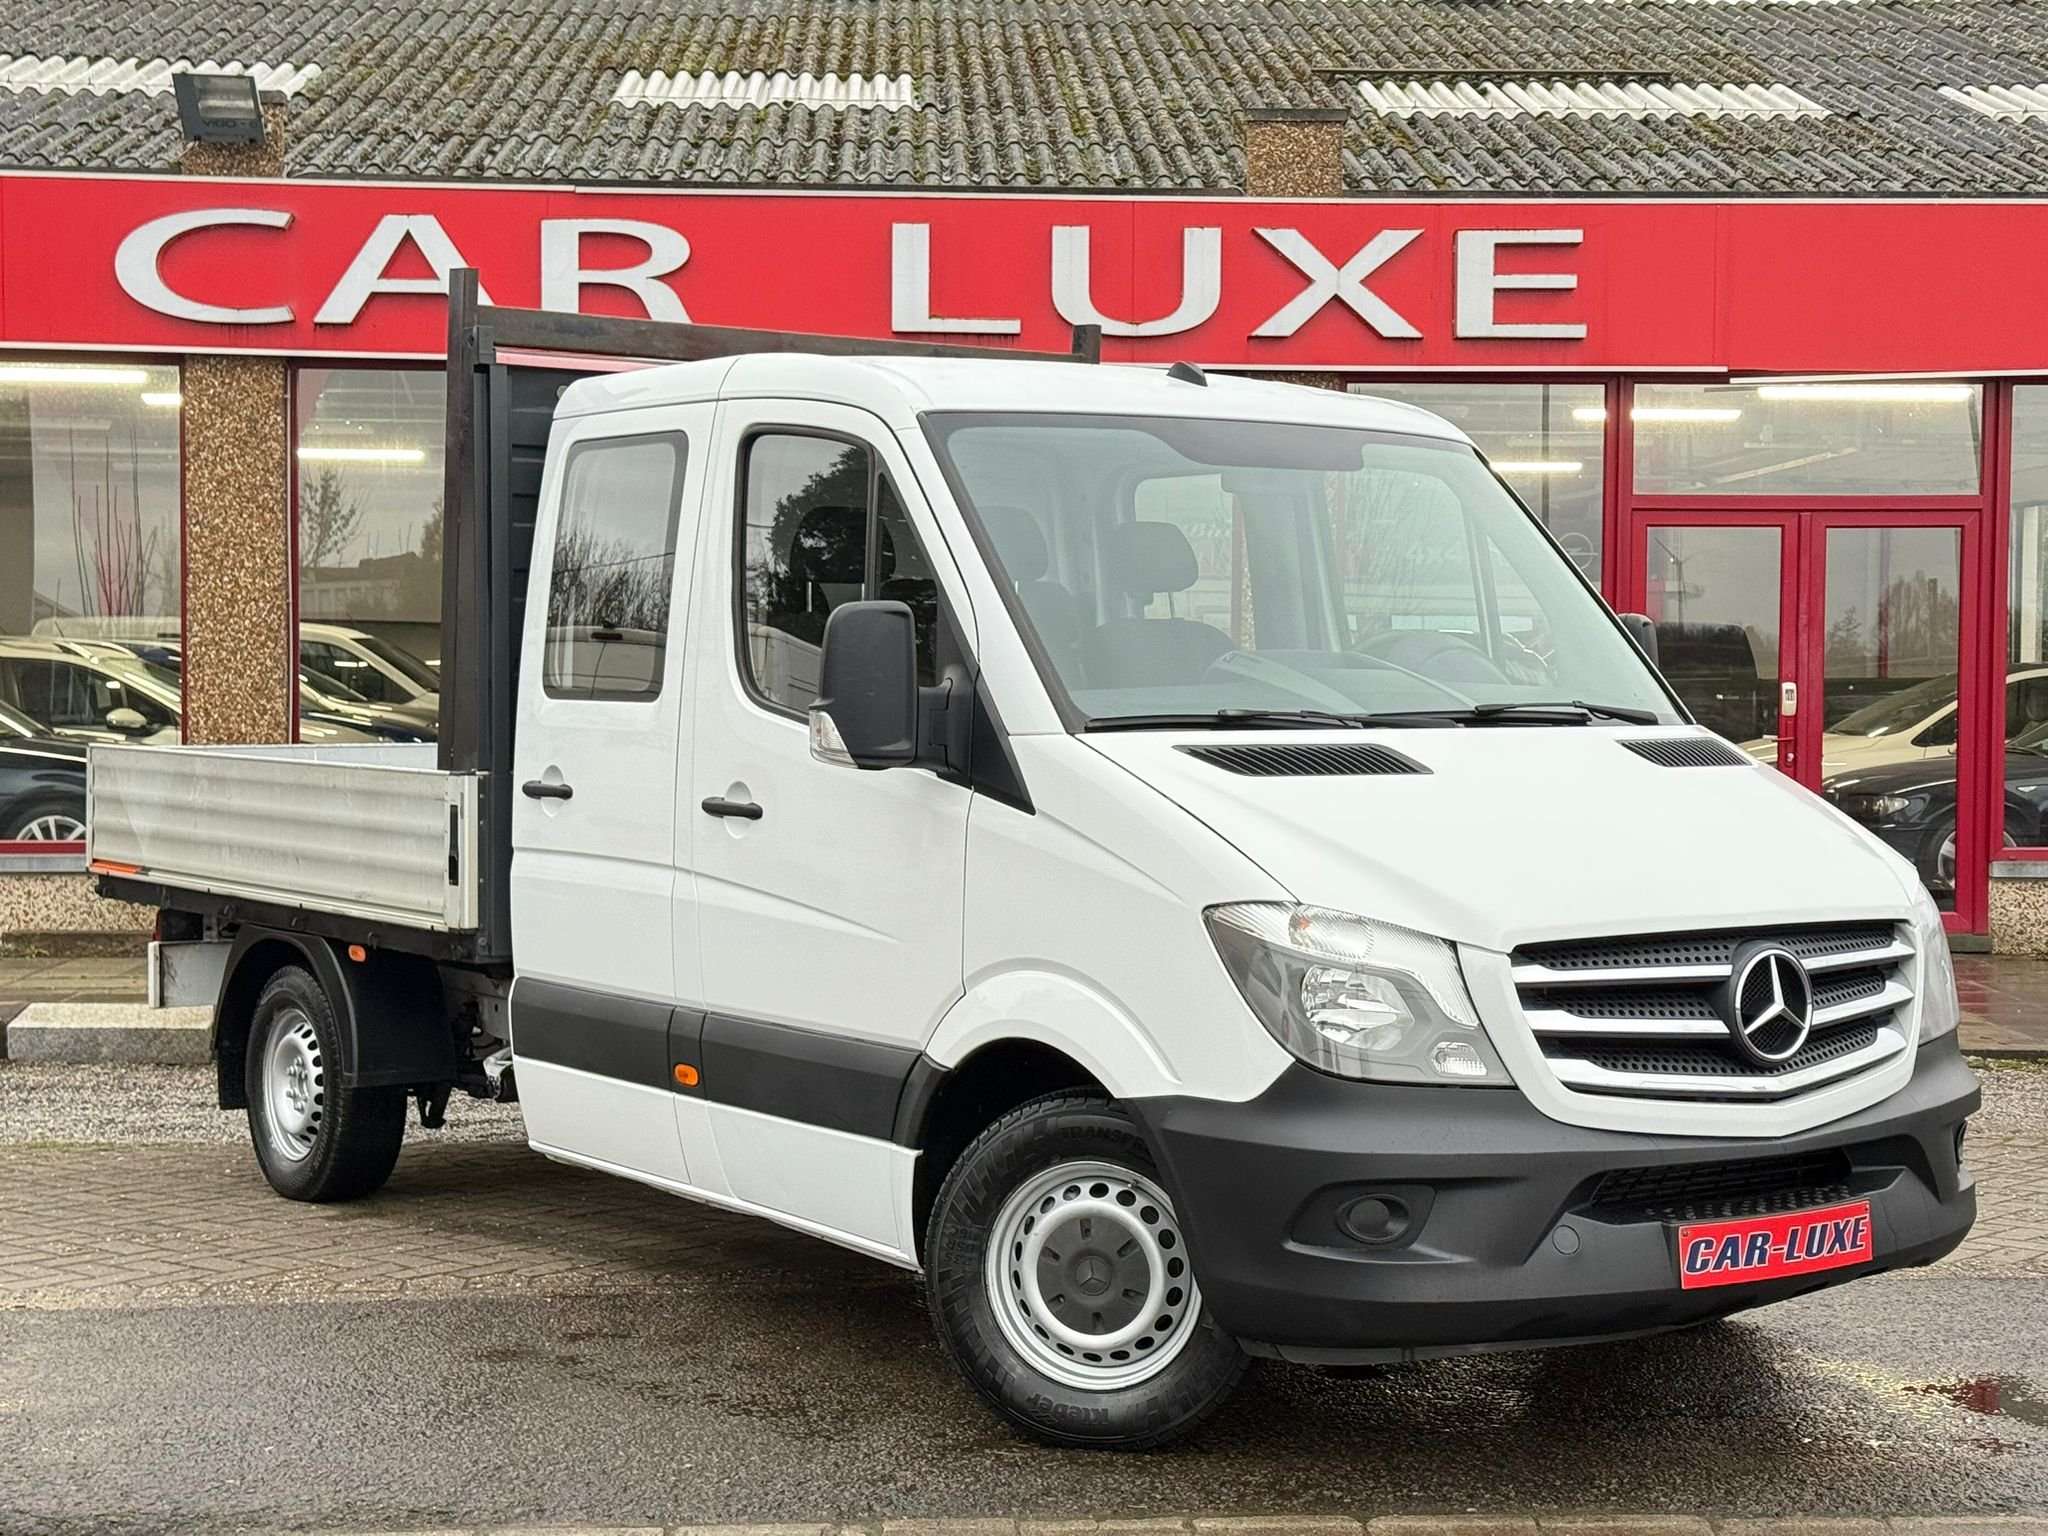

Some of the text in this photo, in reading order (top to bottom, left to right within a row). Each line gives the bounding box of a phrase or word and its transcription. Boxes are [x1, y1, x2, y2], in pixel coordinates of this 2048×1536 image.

[115, 207, 1588, 340] CAR LUXE
[1684, 1215, 1868, 1275] CAR-LUXE
